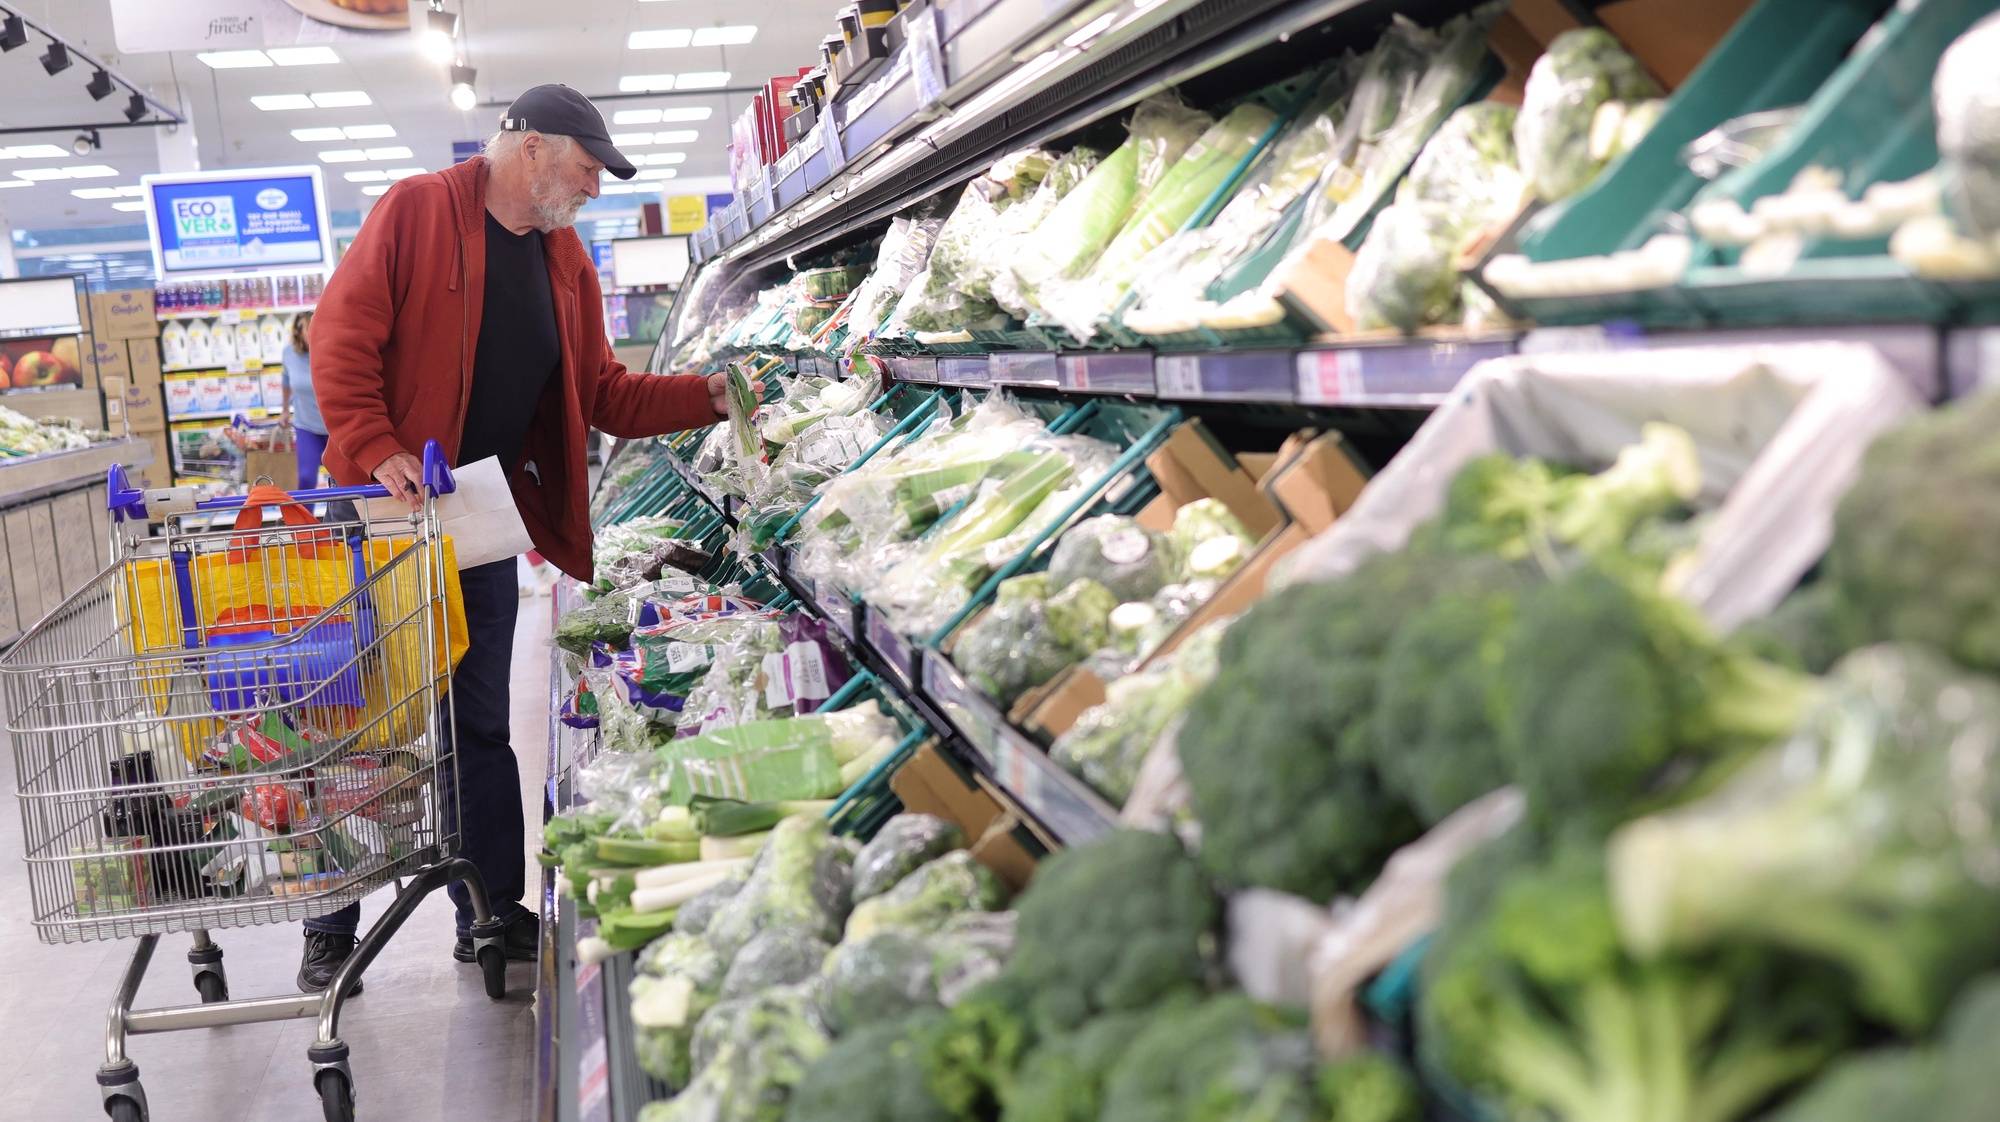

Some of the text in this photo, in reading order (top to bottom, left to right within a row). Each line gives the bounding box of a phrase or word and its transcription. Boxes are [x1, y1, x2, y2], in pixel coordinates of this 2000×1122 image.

[204, 18, 248, 40] finest
[177, 201, 215, 217] ECO
[180, 218, 216, 234] VER
